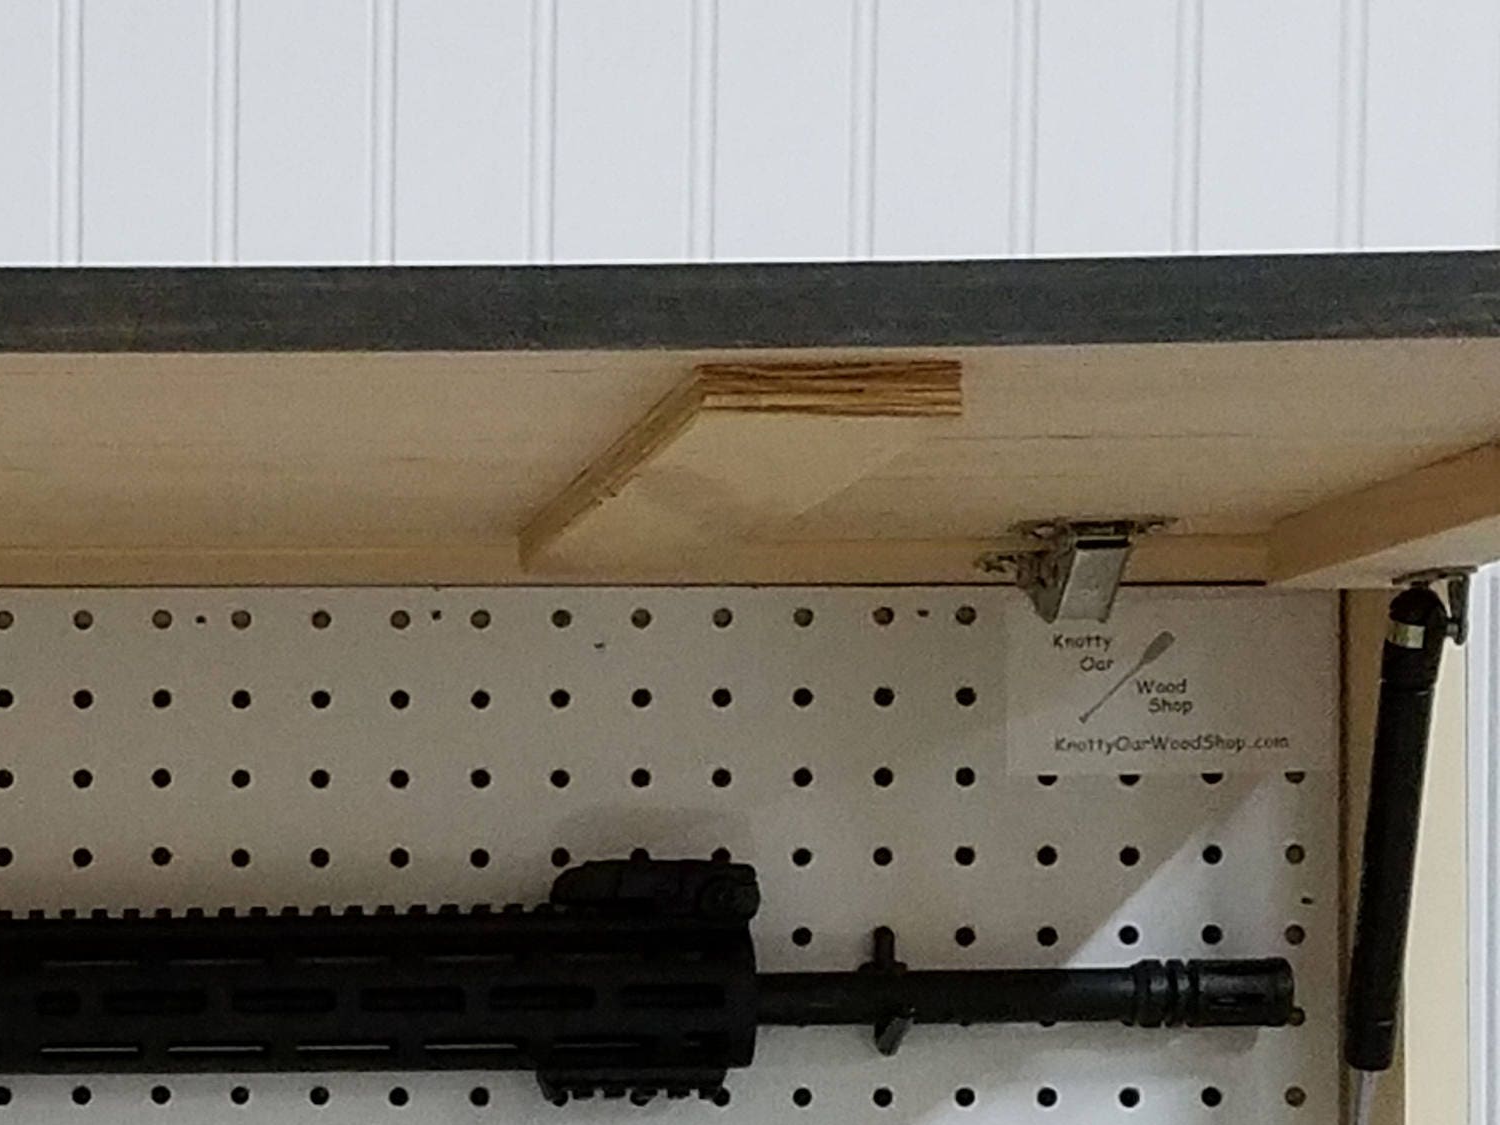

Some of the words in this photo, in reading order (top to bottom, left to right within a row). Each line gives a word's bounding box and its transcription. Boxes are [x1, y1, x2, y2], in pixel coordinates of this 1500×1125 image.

[1053, 634, 1112, 652] Knotty
[1079, 655, 1114, 672] Oar
[1136, 679, 1187, 695] Wood
[1149, 698, 1193, 715] Shop
[1055, 734, 1290, 756] KnottyOarWoodShop.com
